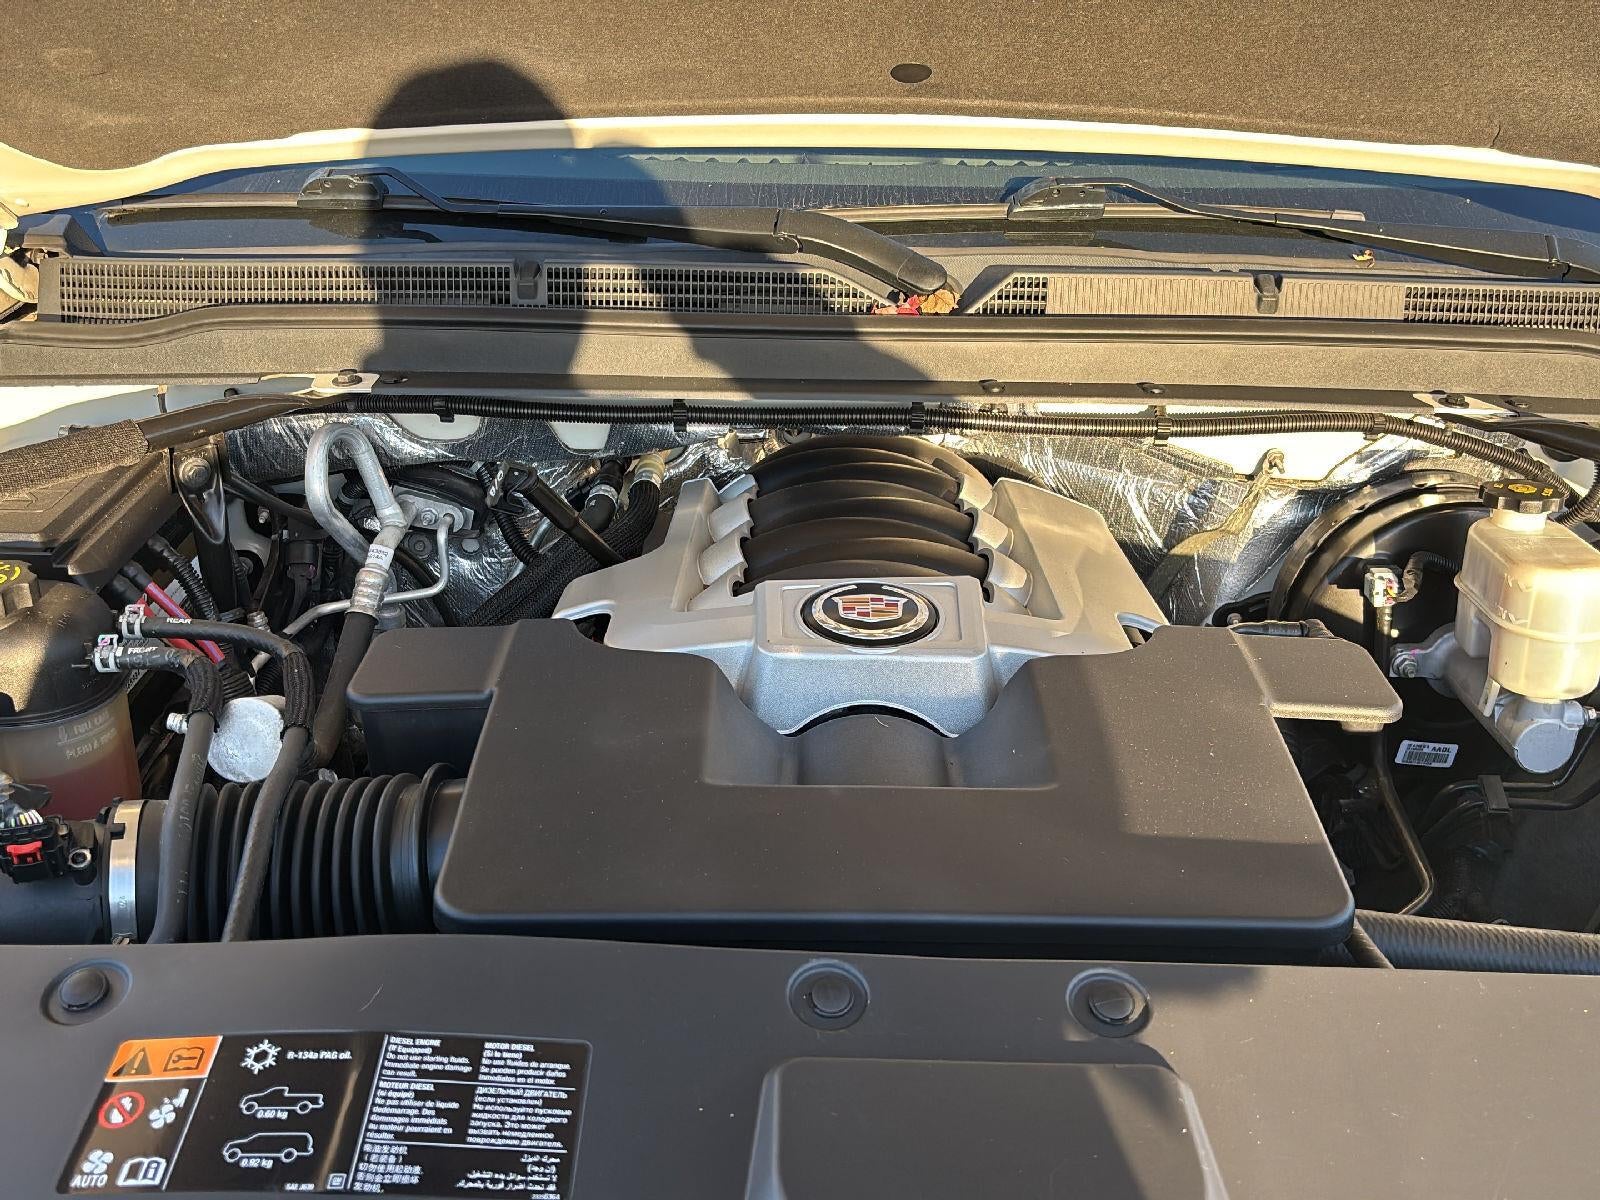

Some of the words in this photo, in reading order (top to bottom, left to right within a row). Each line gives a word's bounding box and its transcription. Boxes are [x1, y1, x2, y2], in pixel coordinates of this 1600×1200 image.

[390, 1036, 414, 1045] DIESEL
[415, 1038, 442, 1046] ENGINE
[484, 1042, 510, 1050] MOTOR
[511, 1043, 535, 1052] DIESEL
[287, 1051, 318, 1059] R-134a
[320, 1051, 338, 1059] PAG
[423, 1055, 448, 1064] starting
[384, 1060, 420, 1069] Immediate
[445, 1065, 472, 1073] damage
[517, 1068, 545, 1076] producir
[546, 1070, 566, 1078] daños
[379, 1081, 408, 1089] MOTEUR
[410, 1083, 435, 1091] DIESEL
[476, 1087, 524, 1096] ДИЗЕЛЬНЫЙ
[524, 1090, 568, 1099] ДВИГАТЕЛЬ
[436, 1100, 460, 1109] liquide
[257, 1110, 275, 1118] 0.60
[277, 1110, 288, 1119] kg
[422, 1108, 435, 1116] Des
[371, 1114, 409, 1123] dommages
[405, 1125, 442, 1133] pourraient
[504, 1121, 520, 1129] Это
[261, 1158, 273, 1169] kg
[70, 1174, 108, 1188] AUTO
